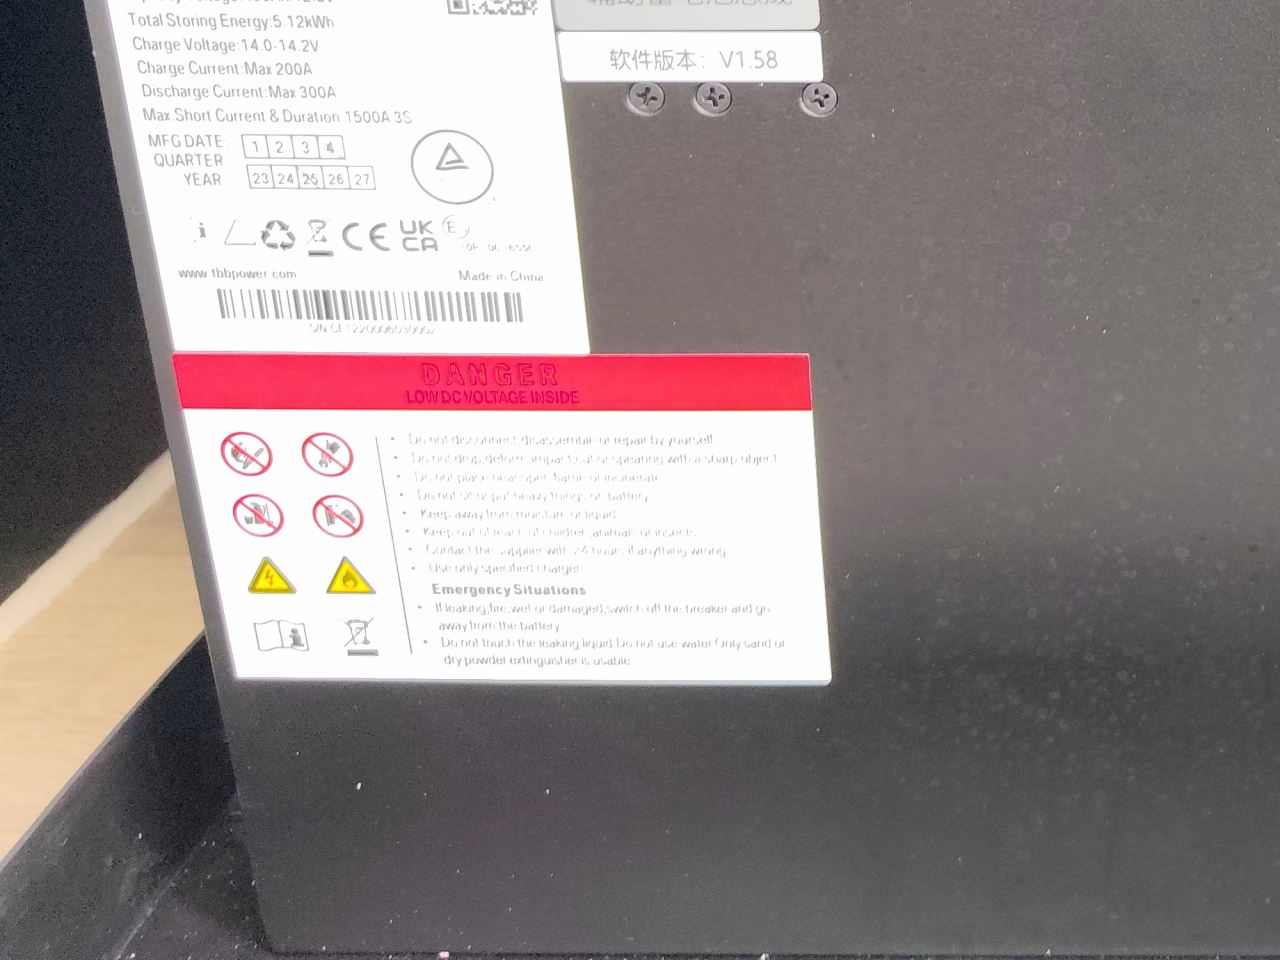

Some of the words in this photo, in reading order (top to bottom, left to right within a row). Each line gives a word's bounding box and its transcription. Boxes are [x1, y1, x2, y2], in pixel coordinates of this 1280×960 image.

[126, 11, 164, 27] Total
[165, 12, 218, 31] Storing
[219, 12, 335, 32] Energy:5.12kWh
[132, 35, 181, 55] Charge
[136, 59, 186, 78] Charge
[188, 60, 273, 76] Current:Max
[275, 61, 313, 76] 200A
[141, 83, 210, 102] Discharge
[212, 83, 297, 99] Current:Max
[298, 85, 337, 99] 300A
[214, 107, 266, 123] Current
[269, 108, 280, 123] &
[282, 108, 340, 124] Duration
[344, 110, 391, 124] 1500A
[393, 110, 413, 125] 3S
[147, 133, 182, 148] MFG
[252, 141, 260, 153] 1
[275, 141, 284, 153] 2
[301, 141, 310, 154] 3
[153, 152, 224, 168] QUARTER
[183, 172, 222, 187] YEAR
[252, 172, 270, 185] 23
[277, 172, 295, 186] 24
[328, 173, 345, 186] 26
[354, 173, 371, 186] 27
[400, 220, 434, 235] UK
[458, 269, 493, 282] Made
[496, 273, 507, 281] in
[420, 361, 559, 387] DANGER
[405, 389, 439, 404] LOW
[440, 390, 462, 404] DC
[463, 390, 528, 405] VOLTAGE
[529, 390, 580, 405] INSIDE
[431, 582, 511, 598] Emergency
[513, 583, 587, 596] Situations
[731, 603, 753, 614] and
[438, 622, 468, 633] away
[498, 620, 517, 631] the
[443, 654, 462, 668] dry
[463, 654, 506, 667] powder
